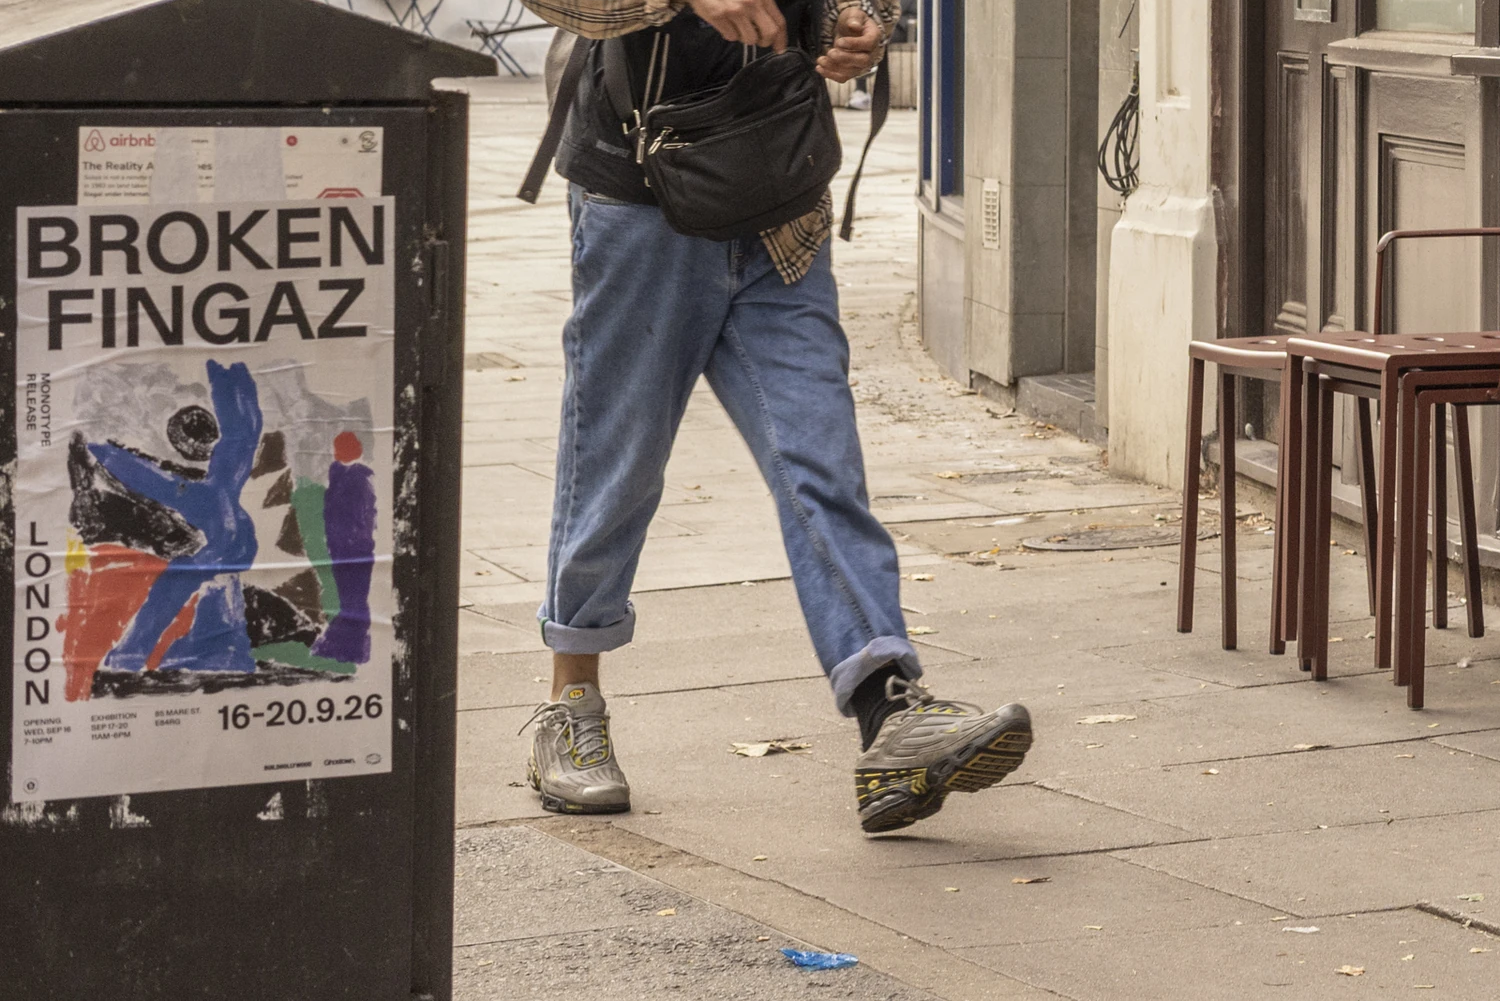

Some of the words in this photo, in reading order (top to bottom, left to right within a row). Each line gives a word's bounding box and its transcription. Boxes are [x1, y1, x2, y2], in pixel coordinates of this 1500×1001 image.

[109, 133, 156, 147] airbnb
[82, 161, 102, 170] The
[105, 161, 143, 171] Reality
[27, 204, 385, 279] BROKEN
[47, 278, 368, 351] FINGAZ
[26, 373, 37, 431] RELEASE
[40, 373, 51, 447] MONOTYPE
[24, 521, 51, 706] LONDON
[165, 708, 189, 717] MARE
[218, 693, 383, 730] 16-20.9.26
[23, 717, 62, 727] OPENING
[91, 712, 137, 722] EXHIBITION
[91, 723, 106, 732] SEP
[107, 722, 128, 730] 17-20
[154, 718, 181, 727] E84RG
[46, 726, 63, 735] SEP
[63, 726, 71, 734] 16
[24, 737, 53, 746] 7-10PM
